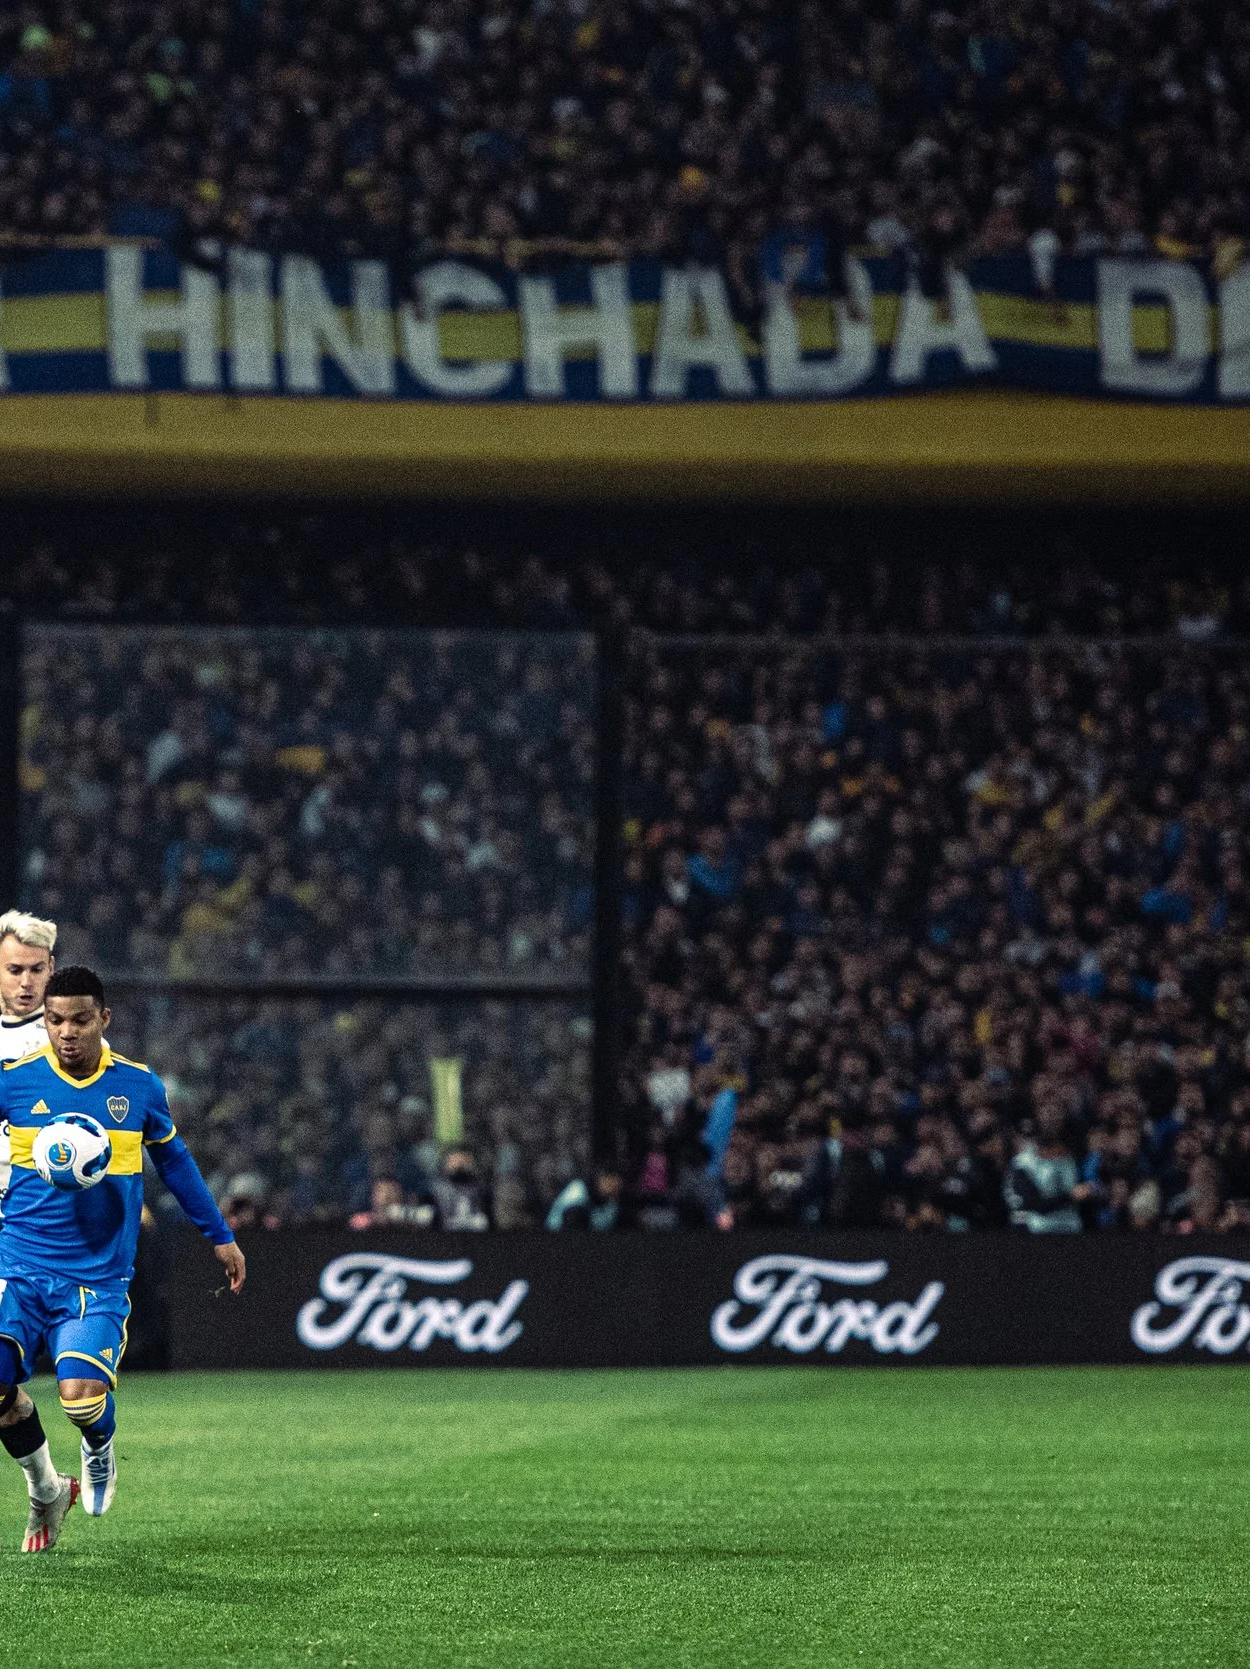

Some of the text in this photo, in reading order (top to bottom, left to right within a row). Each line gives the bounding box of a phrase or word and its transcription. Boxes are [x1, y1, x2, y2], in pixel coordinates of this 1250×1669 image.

[104, 242, 998, 396] HINCHADA
[294, 1251, 530, 1353] Ford
[708, 1253, 945, 1355] Ford
[1129, 1255, 1250, 1355] Fo
